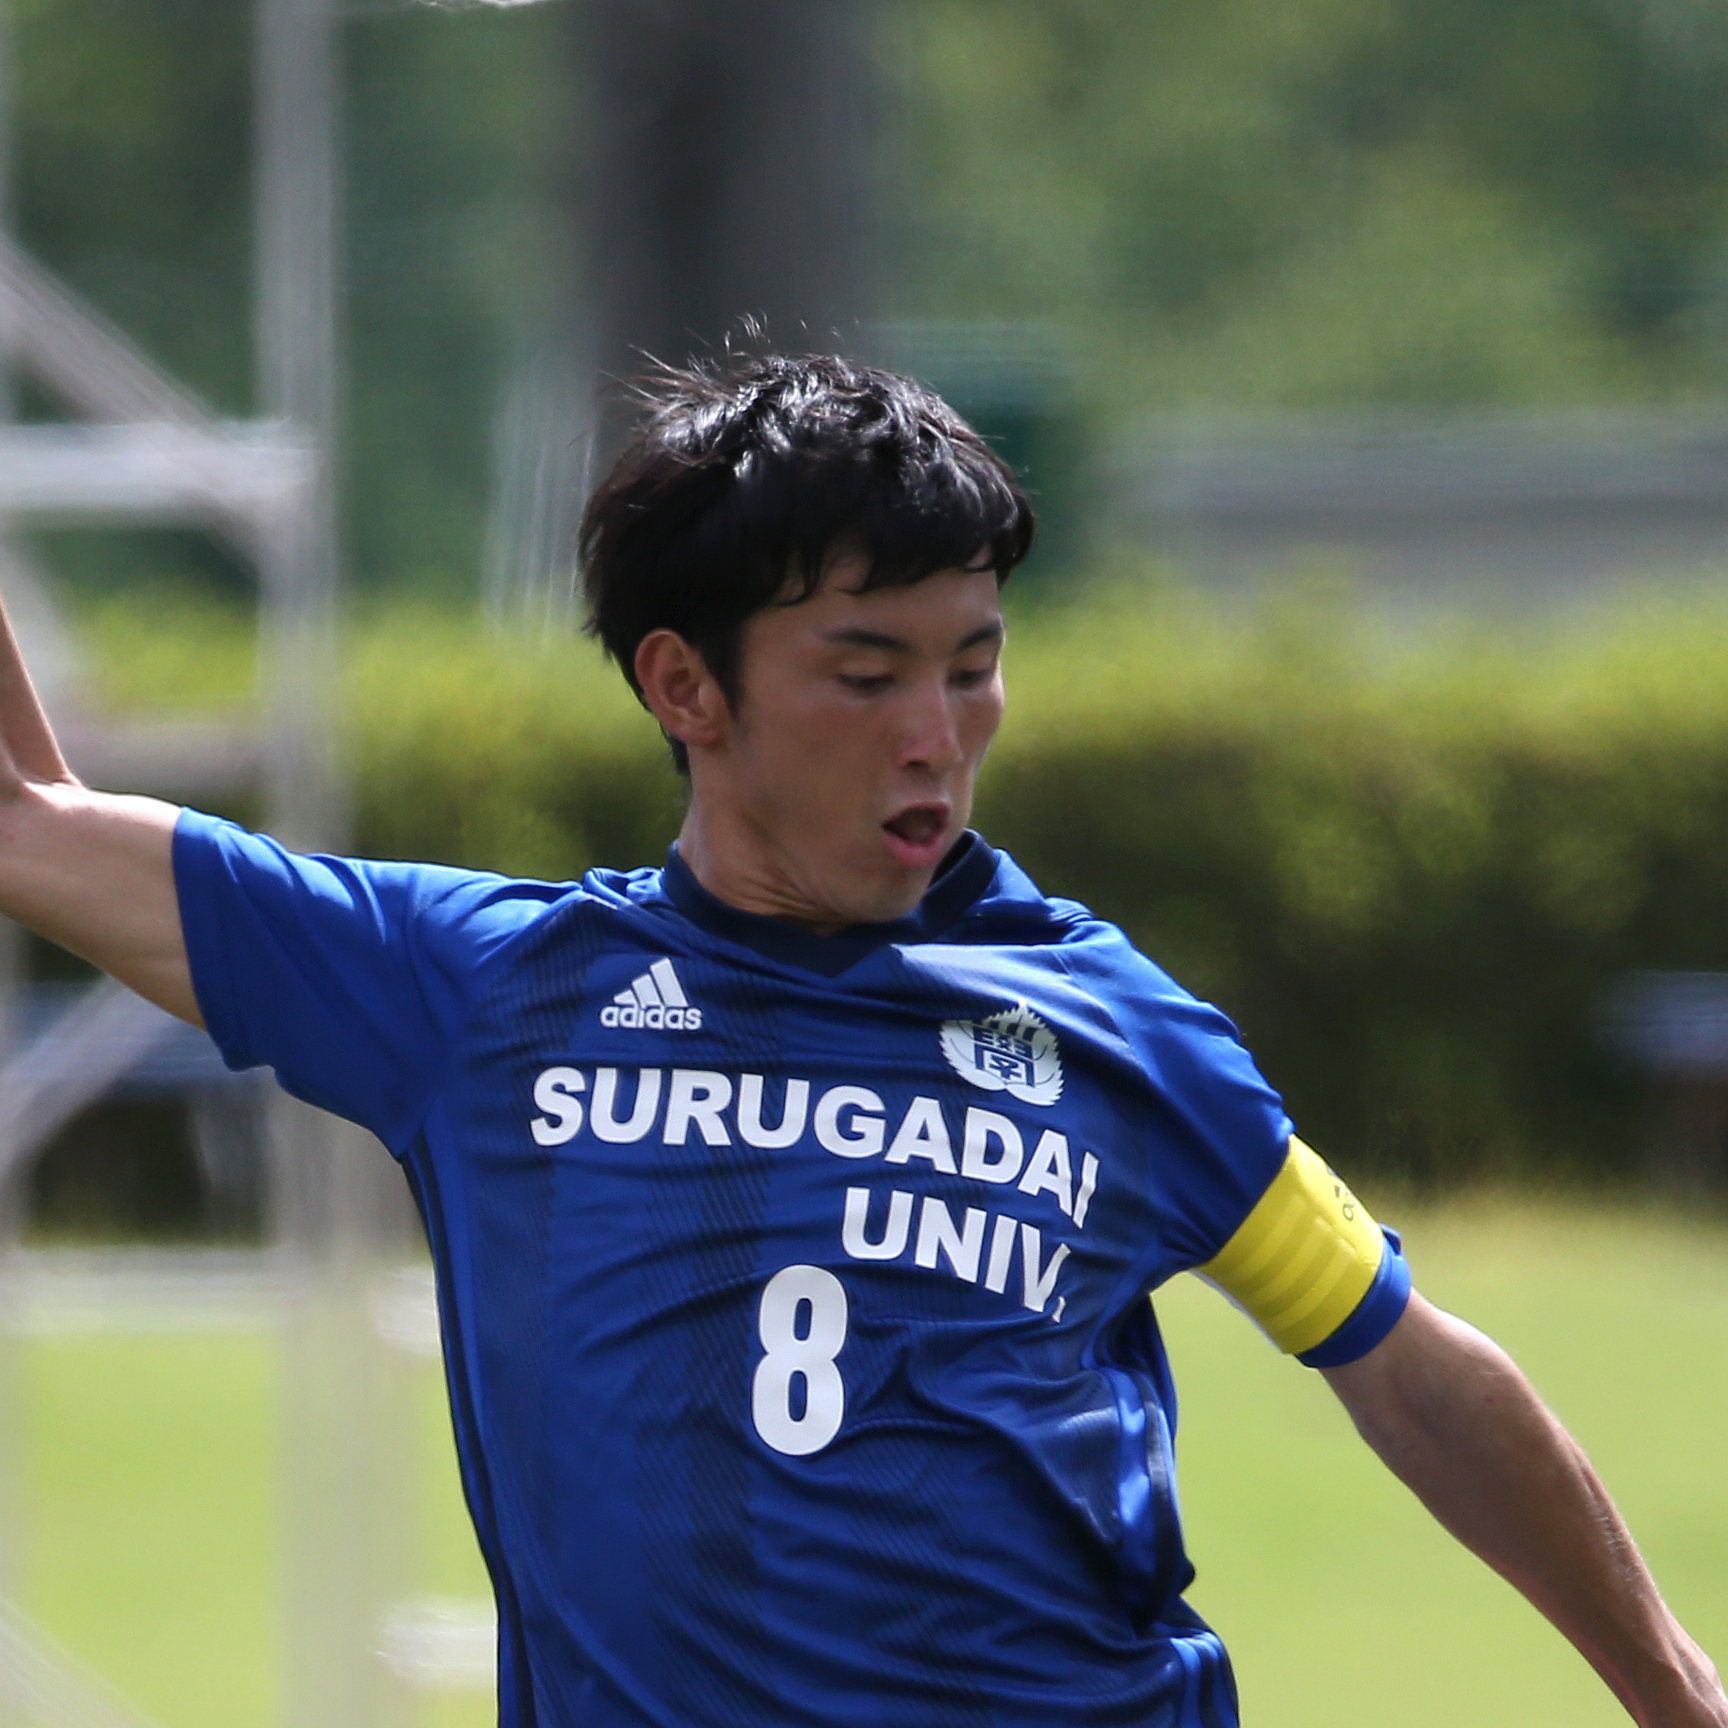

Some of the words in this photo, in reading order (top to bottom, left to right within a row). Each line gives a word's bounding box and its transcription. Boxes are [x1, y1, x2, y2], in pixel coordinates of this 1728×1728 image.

[599, 1002, 703, 1030] adidas
[530, 1066, 1100, 1229] SURUGADAI
[752, 1263, 849, 1456] 8
